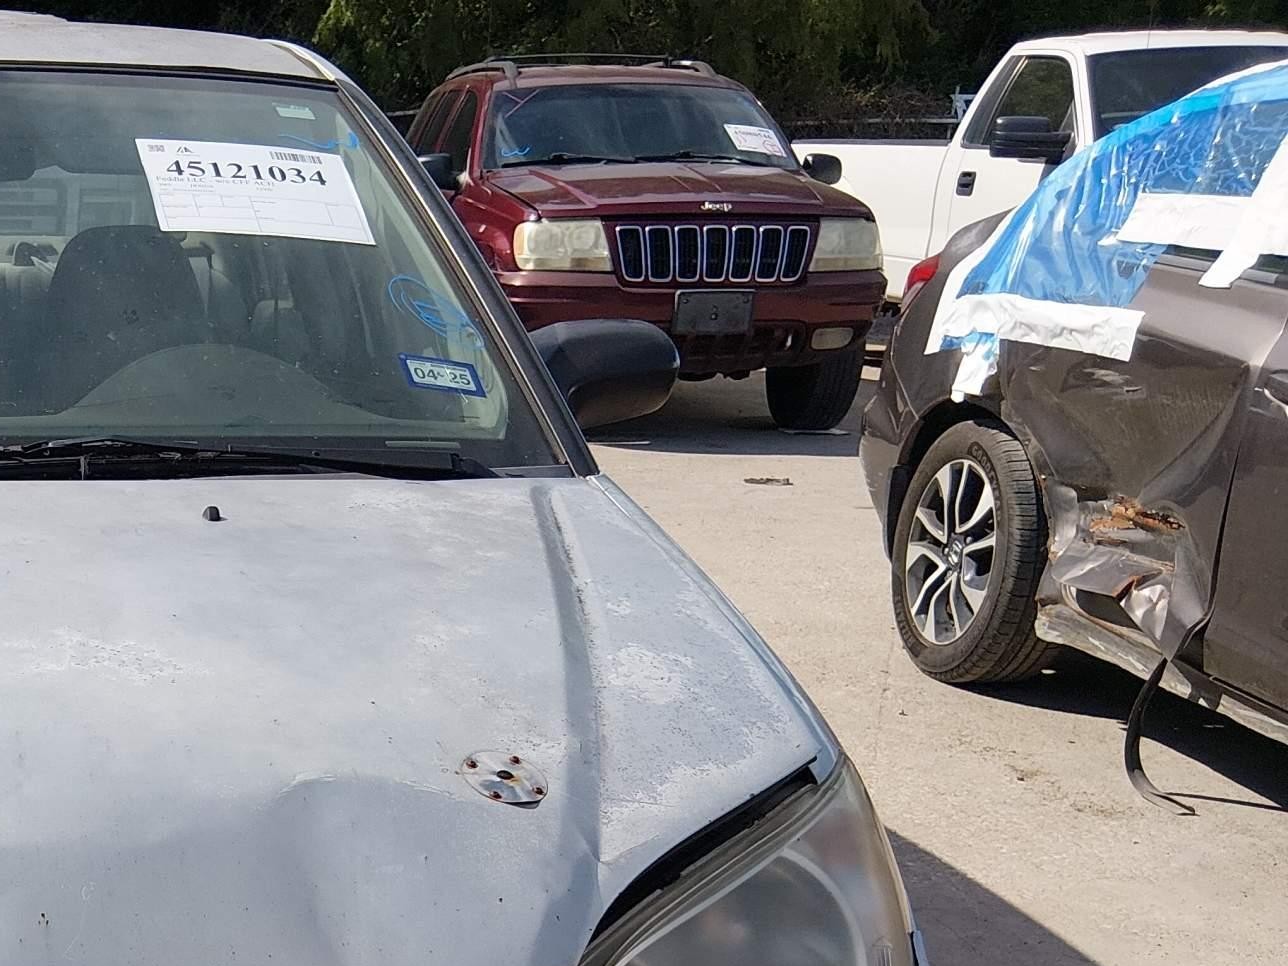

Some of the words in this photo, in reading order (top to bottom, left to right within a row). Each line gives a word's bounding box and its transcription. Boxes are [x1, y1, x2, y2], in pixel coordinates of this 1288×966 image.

[166, 159, 327, 186] 45121034
[700, 201, 733, 213] Jeep
[414, 367, 438, 381] 04
[448, 371, 471, 386] 25
[971, 445, 1002, 521] GOODYEAR
